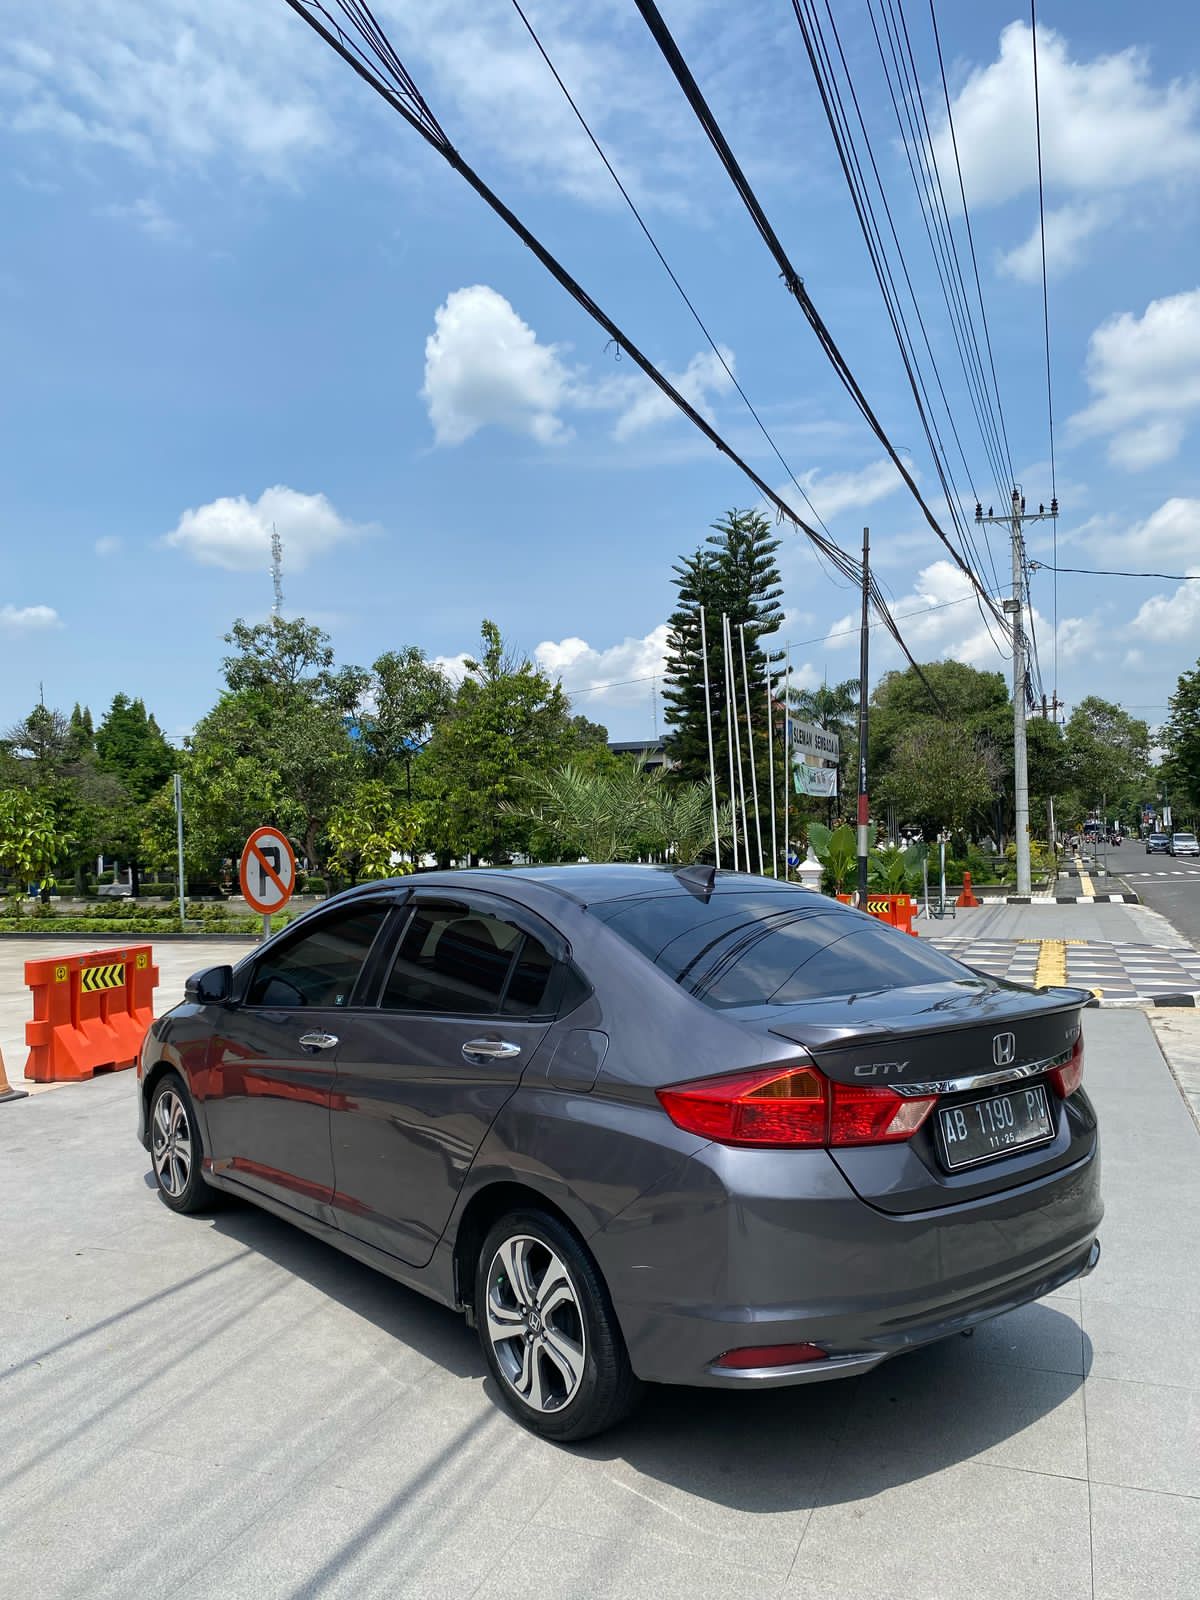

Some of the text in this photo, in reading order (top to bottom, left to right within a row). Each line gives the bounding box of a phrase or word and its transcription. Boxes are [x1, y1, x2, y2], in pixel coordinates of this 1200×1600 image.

[794, 728, 813, 747] SLEMAN
[258, 846, 281, 897] P
[853, 1061, 910, 1077] CITY
[946, 1109, 968, 1144] AB
[975, 1097, 1014, 1134] 1190
